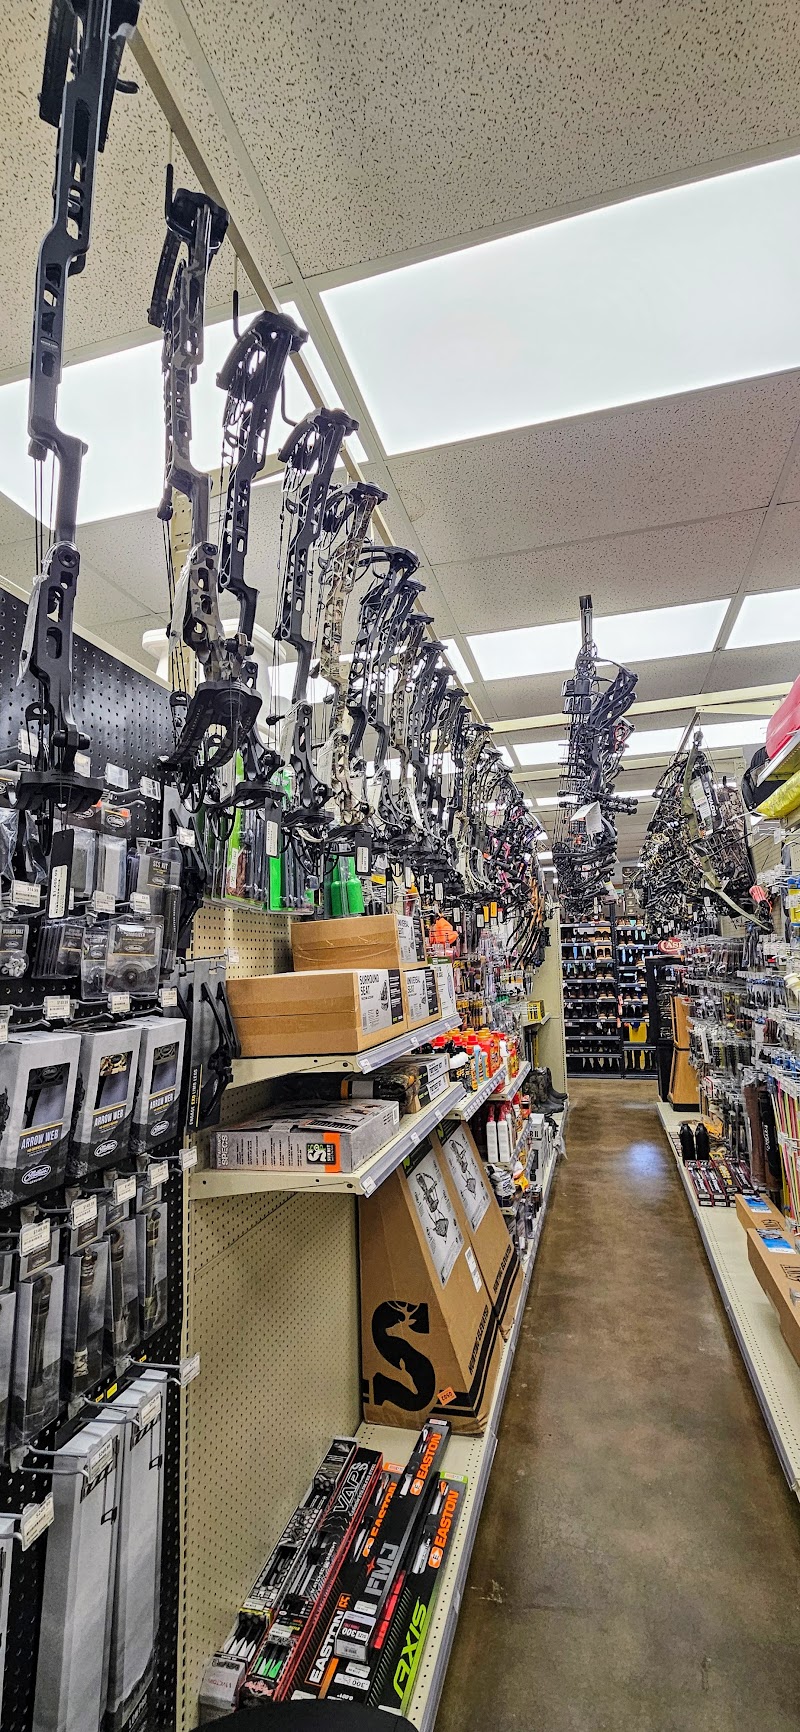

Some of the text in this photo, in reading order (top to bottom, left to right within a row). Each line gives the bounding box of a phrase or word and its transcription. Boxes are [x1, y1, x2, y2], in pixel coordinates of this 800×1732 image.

[360, 985, 370, 996] SEAT
[94, 1112, 113, 1127] ARROW
[112, 1109, 124, 1121] WEB
[150, 1098, 165, 1110] ARROW
[164, 1093, 174, 1105] WEB
[21, 1133, 45, 1150] ARROW
[45, 1129, 59, 1142] WEB
[416, 1433, 442, 1480] EASTON
[434, 1490, 459, 1548] EASTON
[364, 1542, 399, 1596] FMJ
[309, 1610, 345, 1683] EASTON
[341, 1627, 357, 1638] 300
[393, 1600, 427, 1700] AXIS
